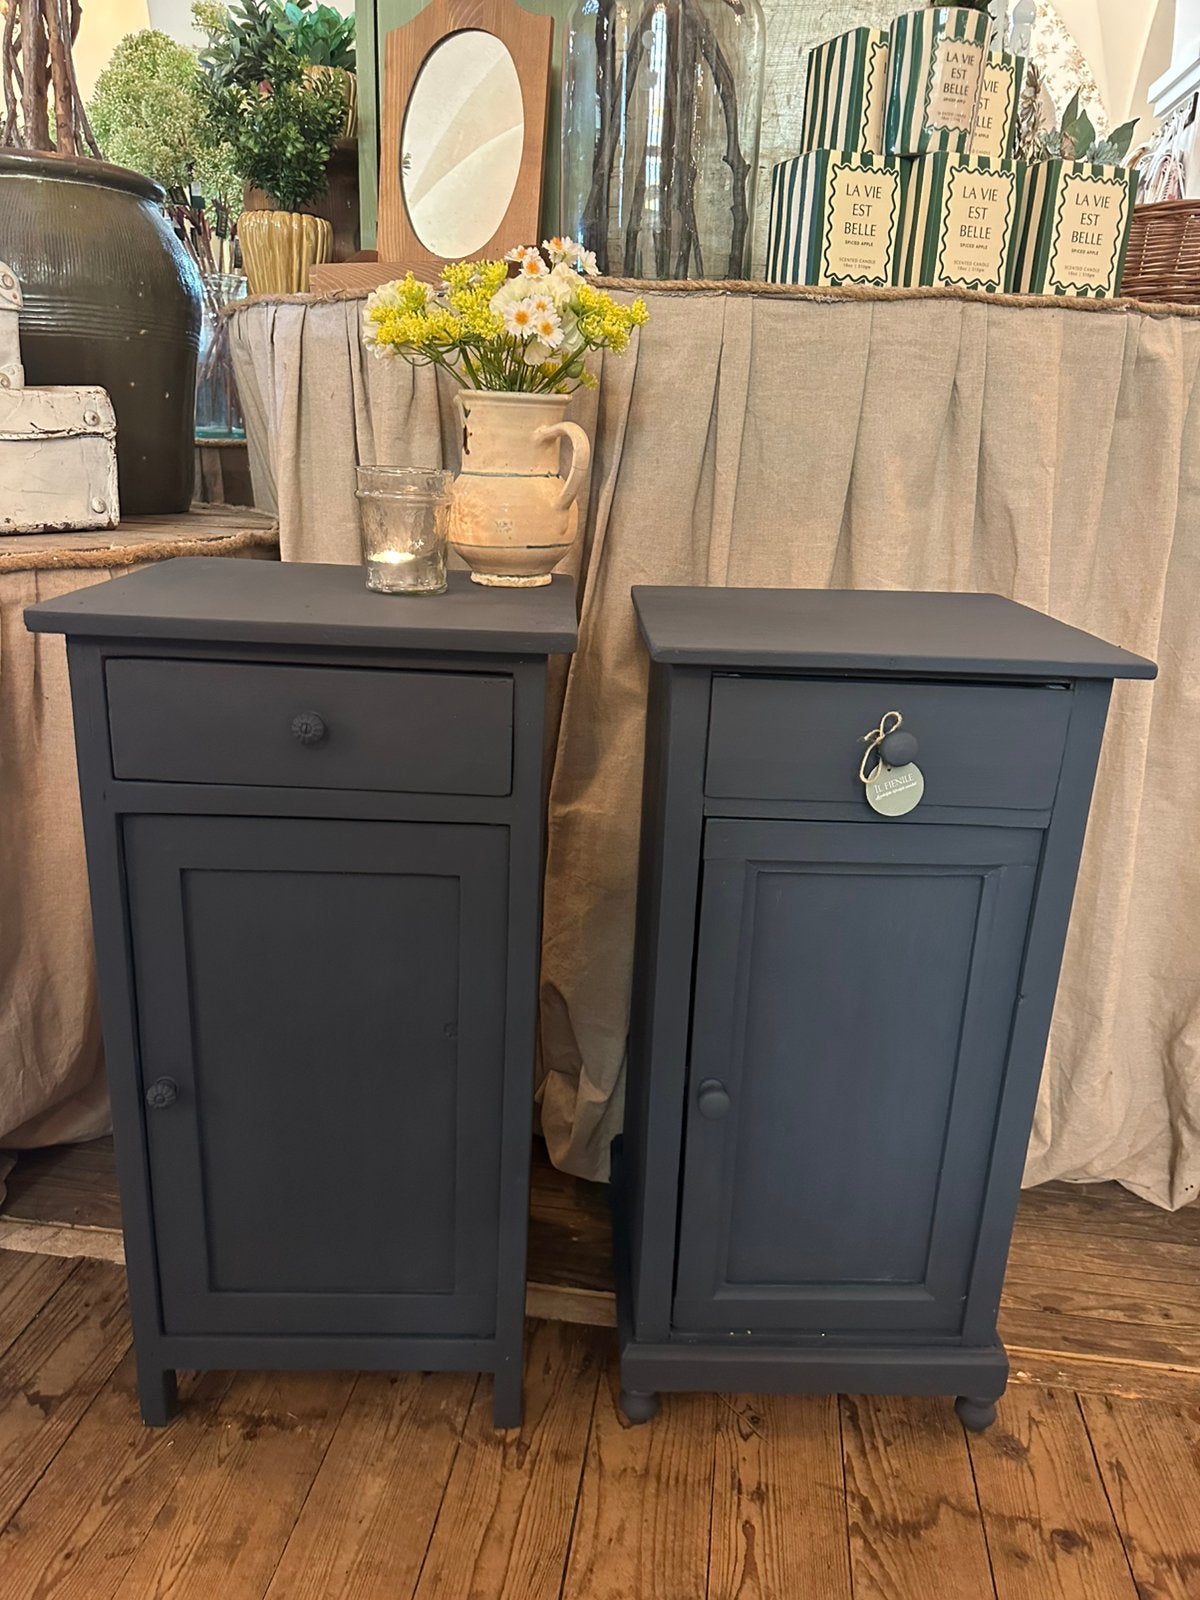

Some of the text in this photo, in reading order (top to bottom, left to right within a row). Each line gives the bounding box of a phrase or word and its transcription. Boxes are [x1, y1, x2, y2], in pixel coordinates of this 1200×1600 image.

[946, 52, 975, 66] LA VIE
[951, 68, 966, 80] EST
[944, 82, 969, 96] BELLE
[983, 80, 999, 93] VIE
[978, 98, 990, 110] ST
[846, 184, 882, 199] LA VIE
[963, 186, 998, 201] LA VIE
[1075, 193, 1110, 209] LA VIE
[852, 203, 872, 217] EST
[968, 206, 988, 219] EST
[1081, 213, 1100, 226] EST
[844, 222, 876, 237] BELLE
[960, 225, 991, 239] BELLE
[1072, 231, 1102, 245] BELLE
[875, 785, 881, 793] IL
[884, 774, 913, 790] FIENILE
